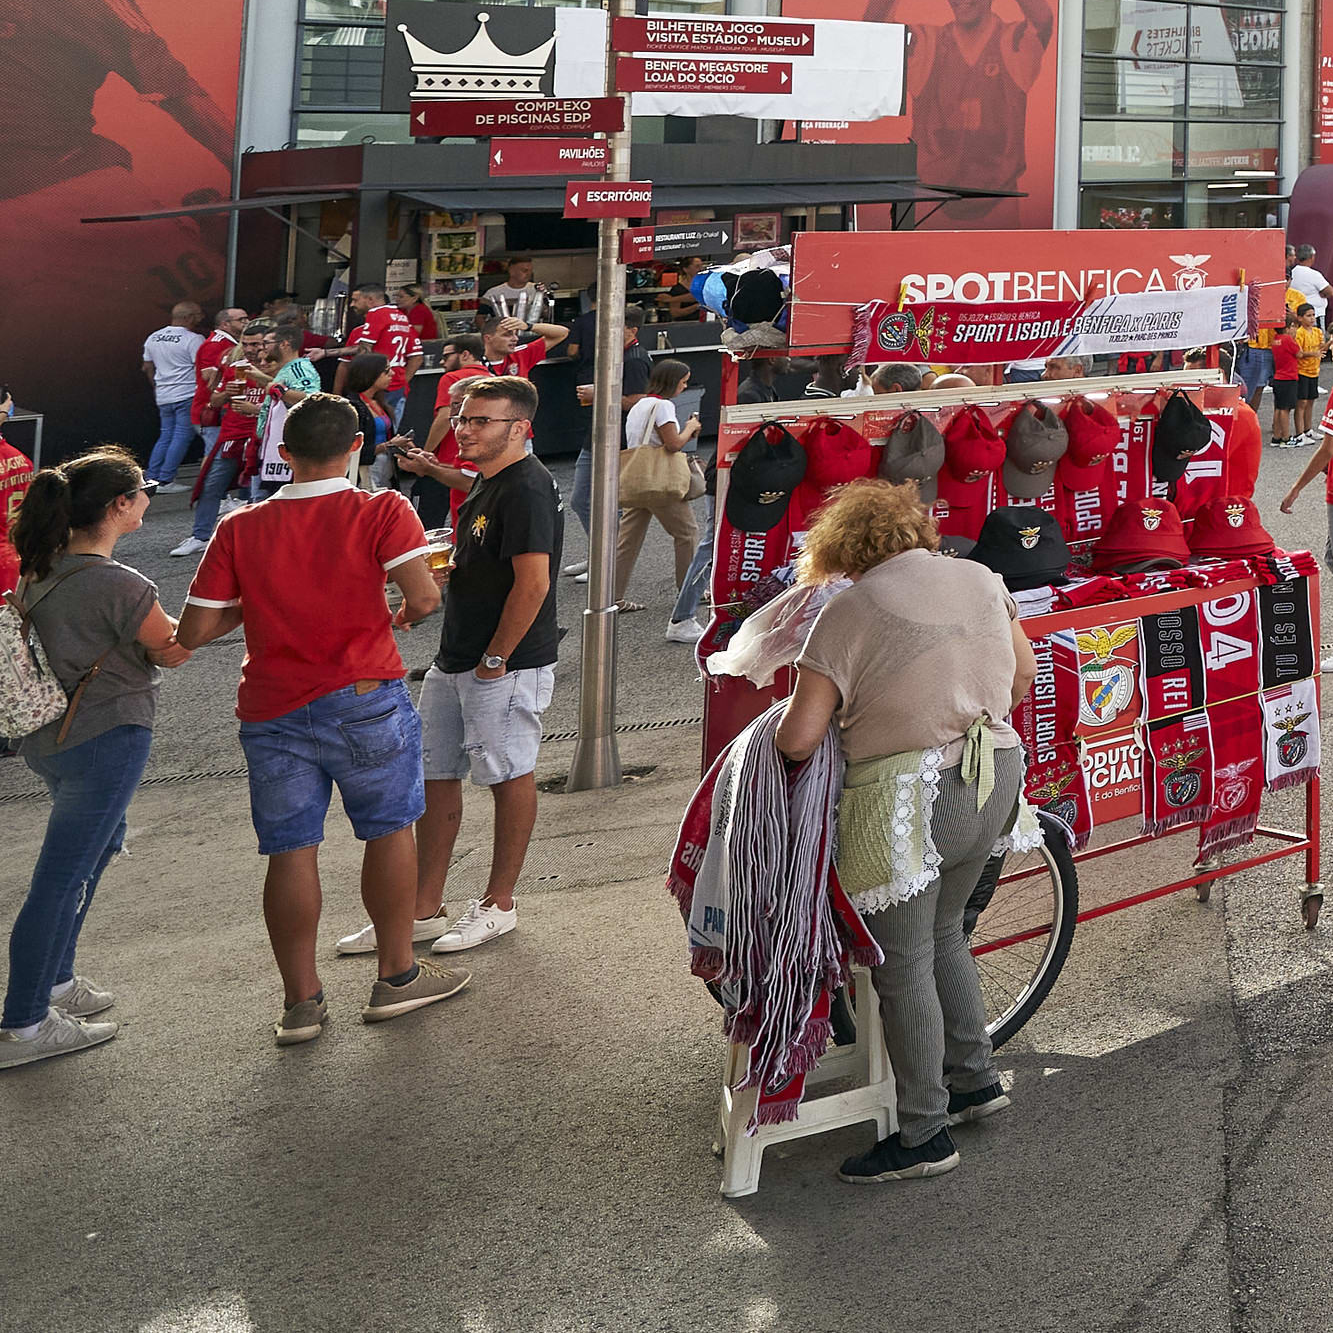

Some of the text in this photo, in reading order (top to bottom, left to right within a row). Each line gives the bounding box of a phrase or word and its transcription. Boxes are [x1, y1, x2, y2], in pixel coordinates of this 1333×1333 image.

[647, 21, 764, 34] BILHETEIRA JOGO
[647, 32, 800, 46] VISITA ESTÁDIO MUSEU
[645, 61, 768, 73] BENFICA MEGASTORE
[645, 71, 735, 83] LOJA DO SÓCIO
[515, 101, 591, 112] COMPLEXO
[475, 113, 591, 125] DE PISCINAS EDP
[559, 146, 605, 159] PAVILHÕES
[1219, 293, 1238, 332] PARIS
[953, 324, 1006, 343] SPORT
[1073, 315, 1130, 335] BENFICA
[1141, 312, 1183, 331] PARIS
[265, 463, 290, 476] 1904
[1156, 609, 1186, 670] OSSO
[1275, 654, 1299, 678] TU
[1161, 677, 1188, 709] REI
[1035, 713, 1057, 764] SPORT
[1101, 791, 1112, 800] do
